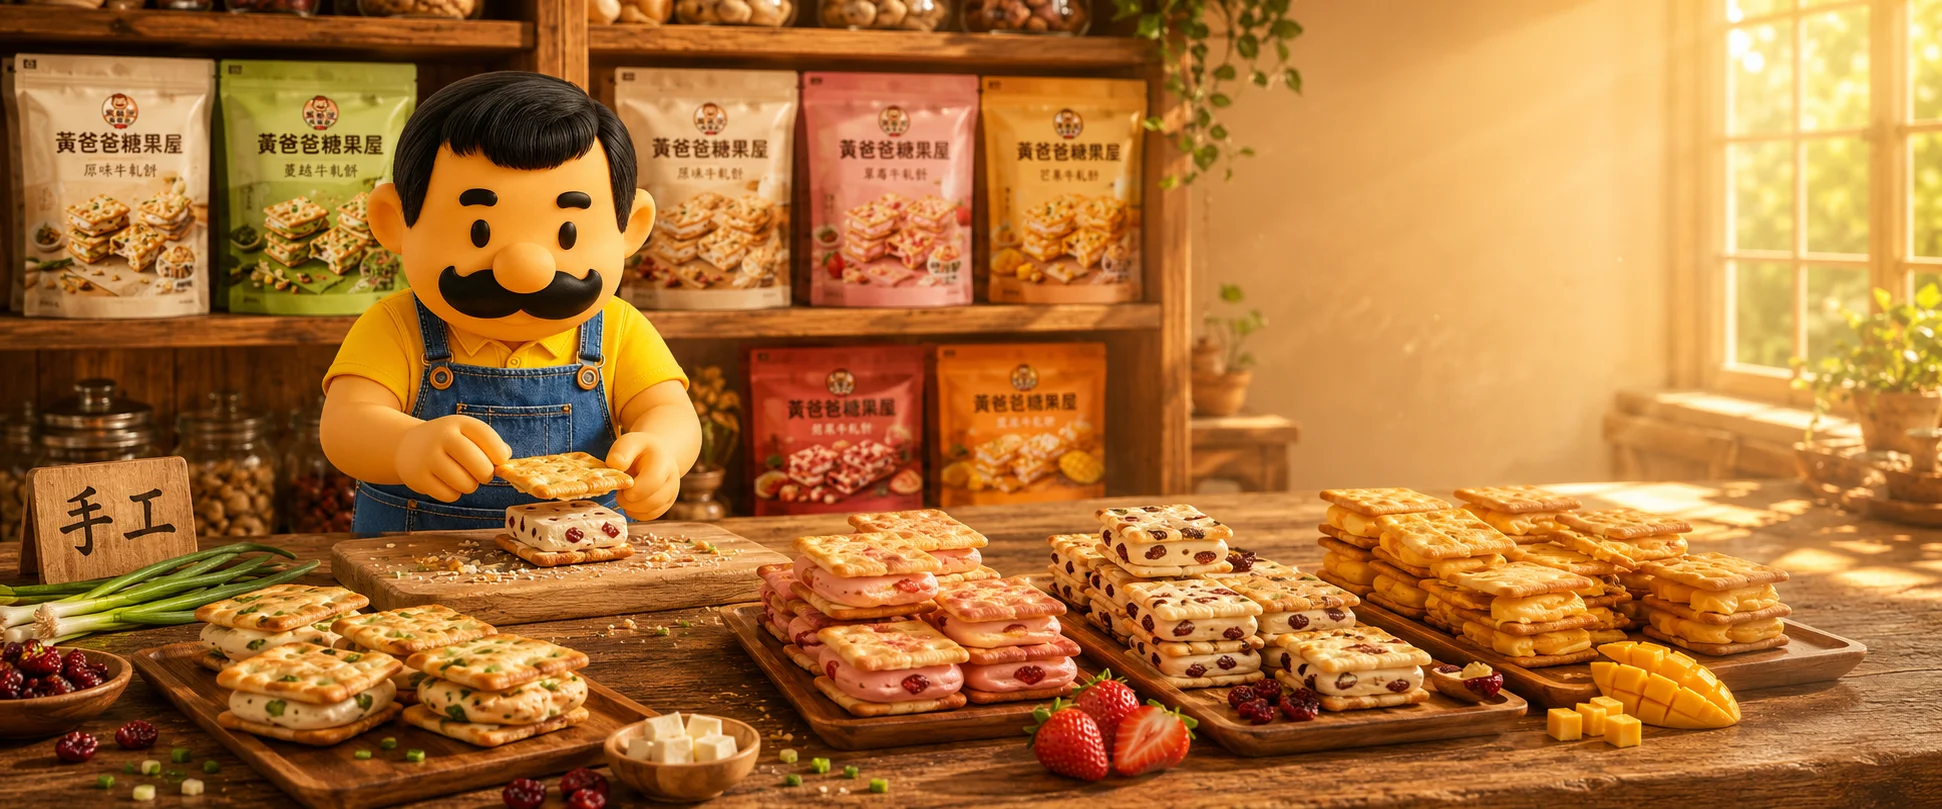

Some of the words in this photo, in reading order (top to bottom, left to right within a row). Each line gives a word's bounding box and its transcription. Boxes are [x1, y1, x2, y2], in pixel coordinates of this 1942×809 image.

[56, 131, 183, 154] 黃爸爸糖果屋
[258, 133, 383, 155] 黃爸爸糖果屋
[652, 137, 768, 159] 黃爸爸糖果屋
[839, 139, 950, 160] 黃爸爸糖果屋
[1017, 142, 1121, 161] 黃爸爸糖果屋
[84, 163, 157, 178] 原味牛軋餅
[284, 163, 359, 178] 蔓越牛軋餅
[787, 398, 896, 419] 黃爸爸糖果屋
[974, 392, 1077, 413] 黃爸爸糖果屋
[60, 486, 176, 556] 手工
